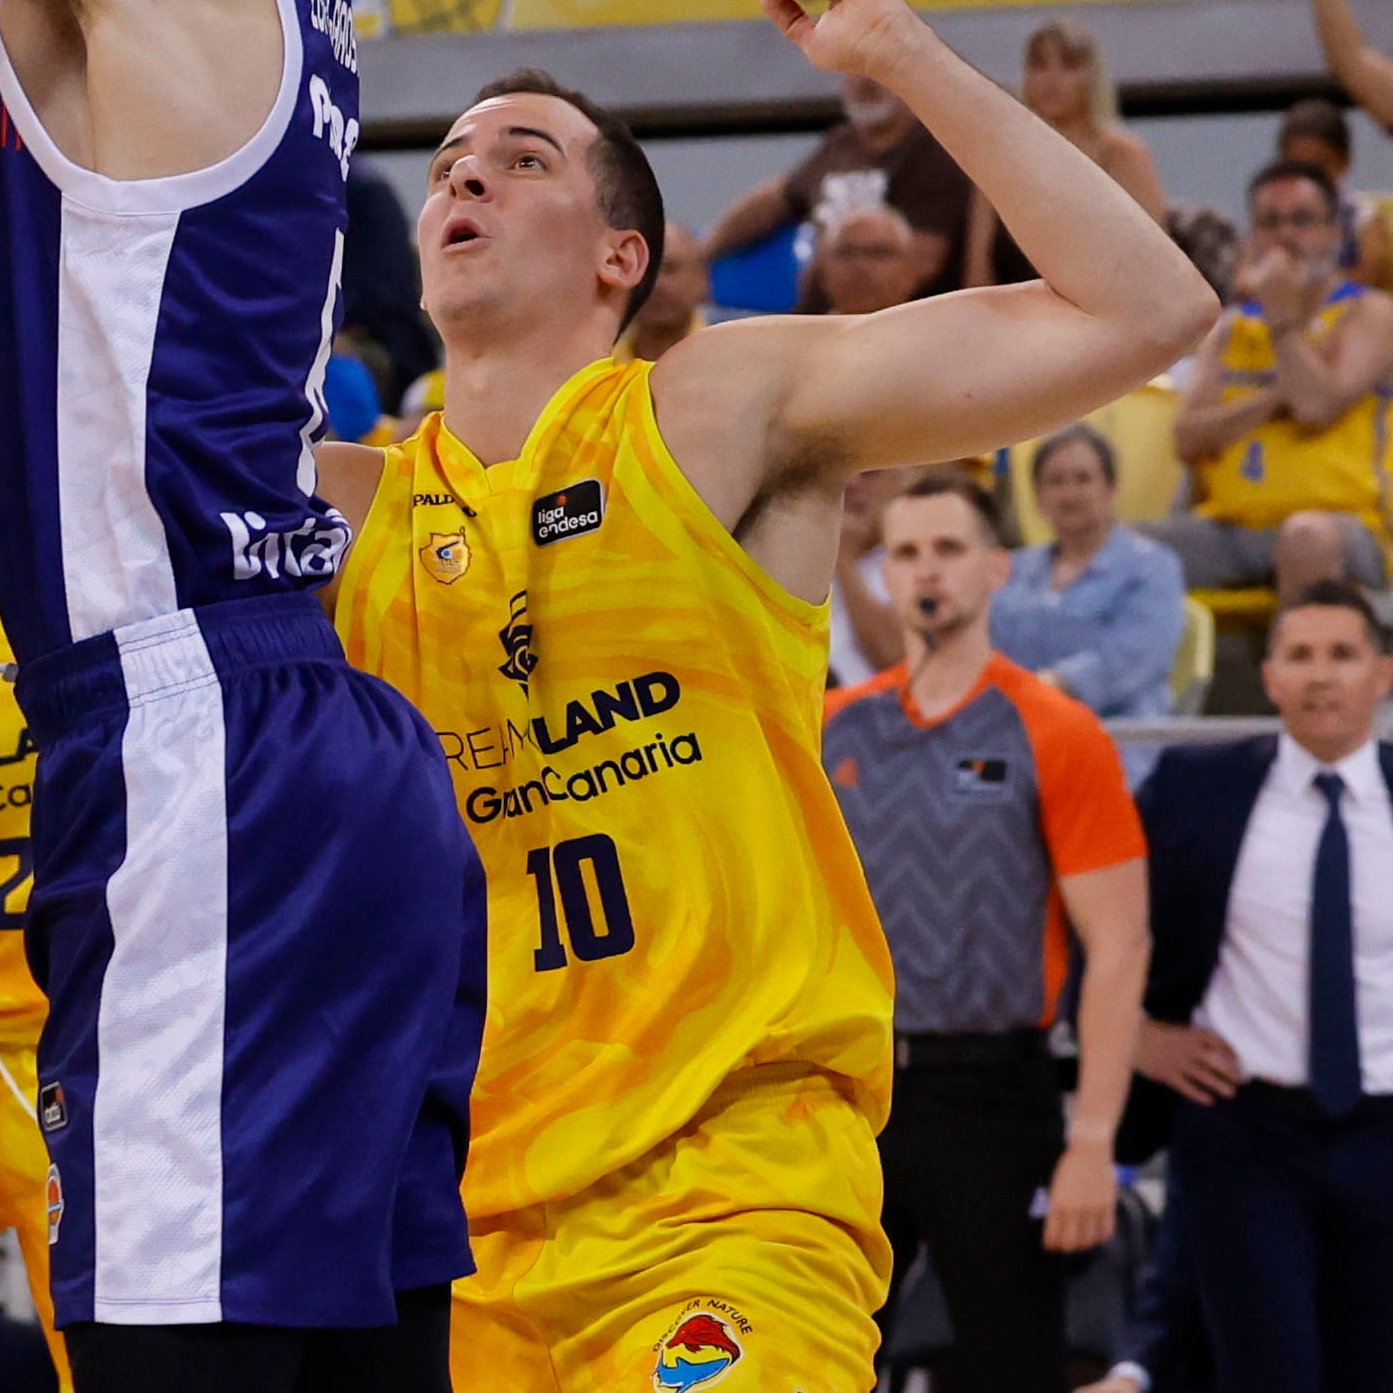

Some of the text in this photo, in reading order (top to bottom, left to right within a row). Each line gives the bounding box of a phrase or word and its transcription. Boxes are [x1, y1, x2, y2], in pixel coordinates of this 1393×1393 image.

[537, 506, 564, 525] liga
[538, 511, 599, 539] endesa
[526, 833, 636, 973] 10
[707, 1299, 753, 1335] NATURE
